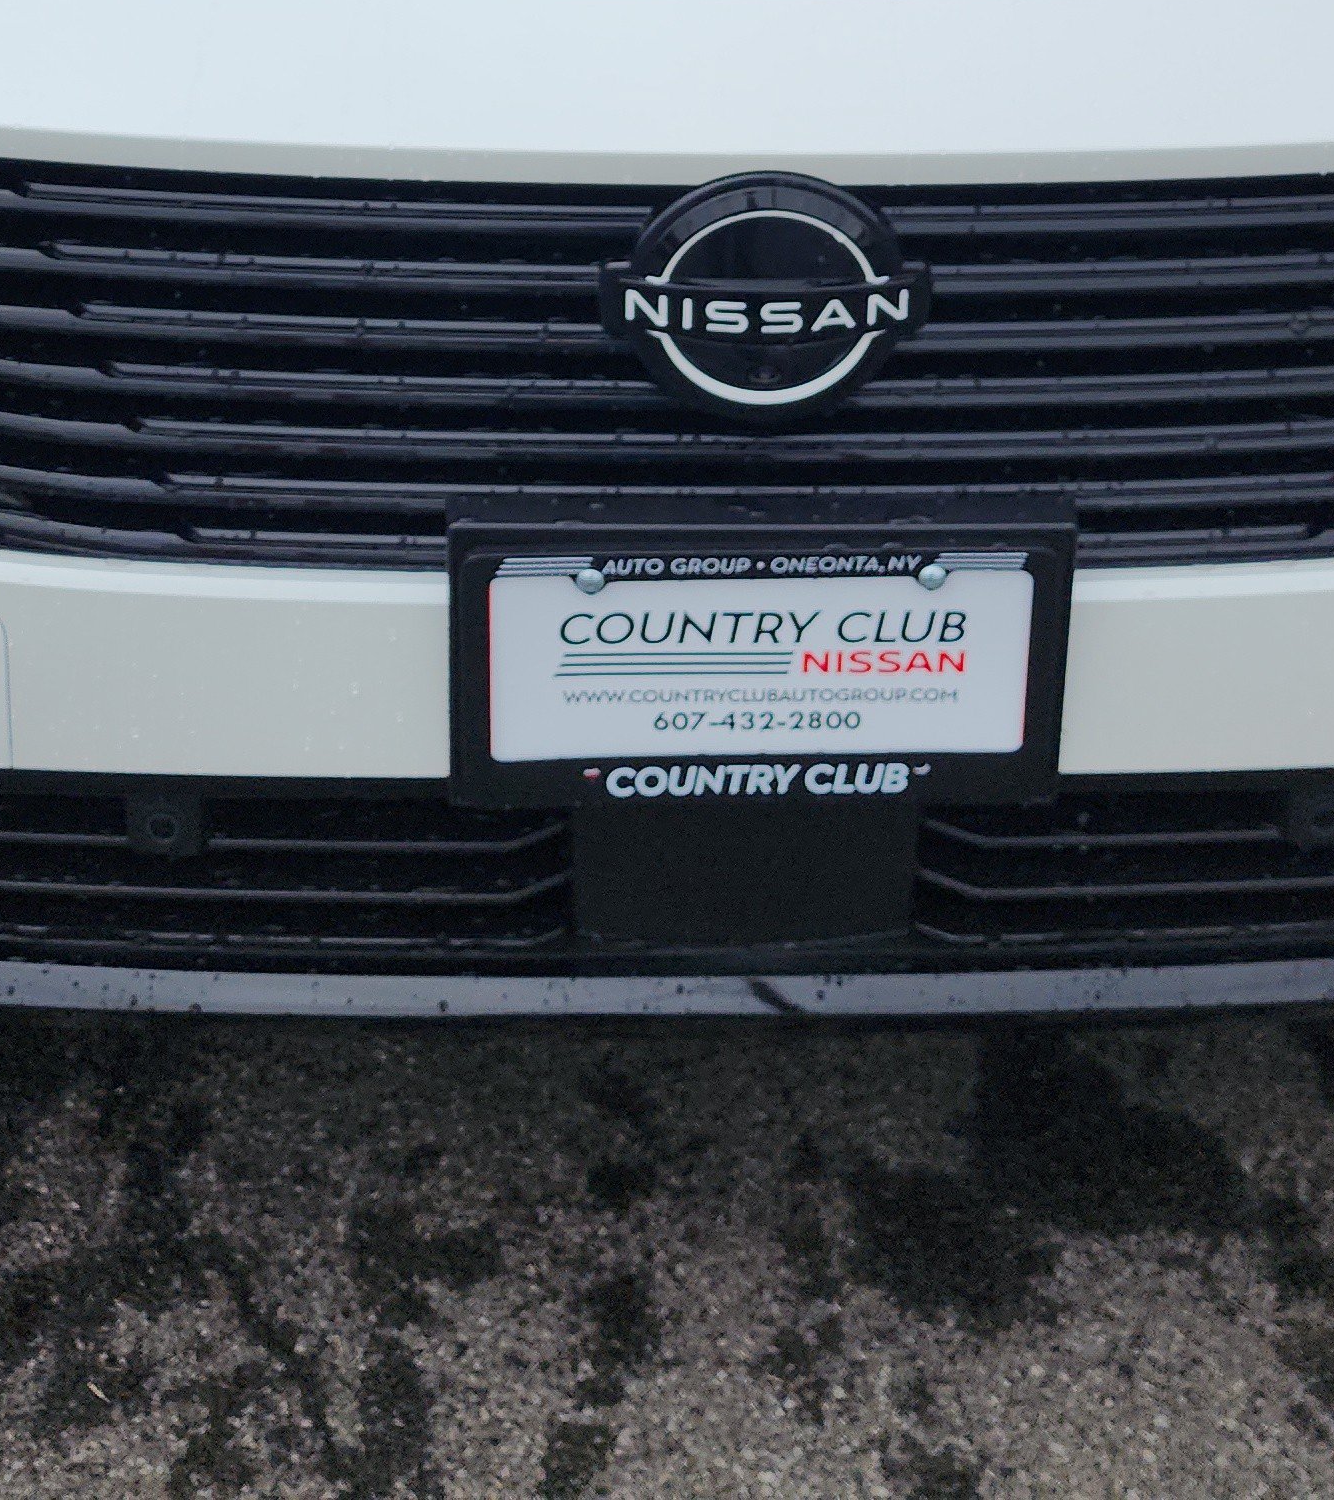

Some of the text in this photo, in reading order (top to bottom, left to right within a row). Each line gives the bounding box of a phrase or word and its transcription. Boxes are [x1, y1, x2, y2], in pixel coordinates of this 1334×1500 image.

[624, 288, 910, 334] NISSAN
[602, 558, 664, 576] AUTO
[670, 557, 751, 575] GROUP
[560, 611, 967, 645] COUNTRY CLUB
[801, 650, 967, 674] NISSAN
[653, 711, 862, 732] 607-432-2800
[605, 762, 910, 798] COUNTRY CLUB
